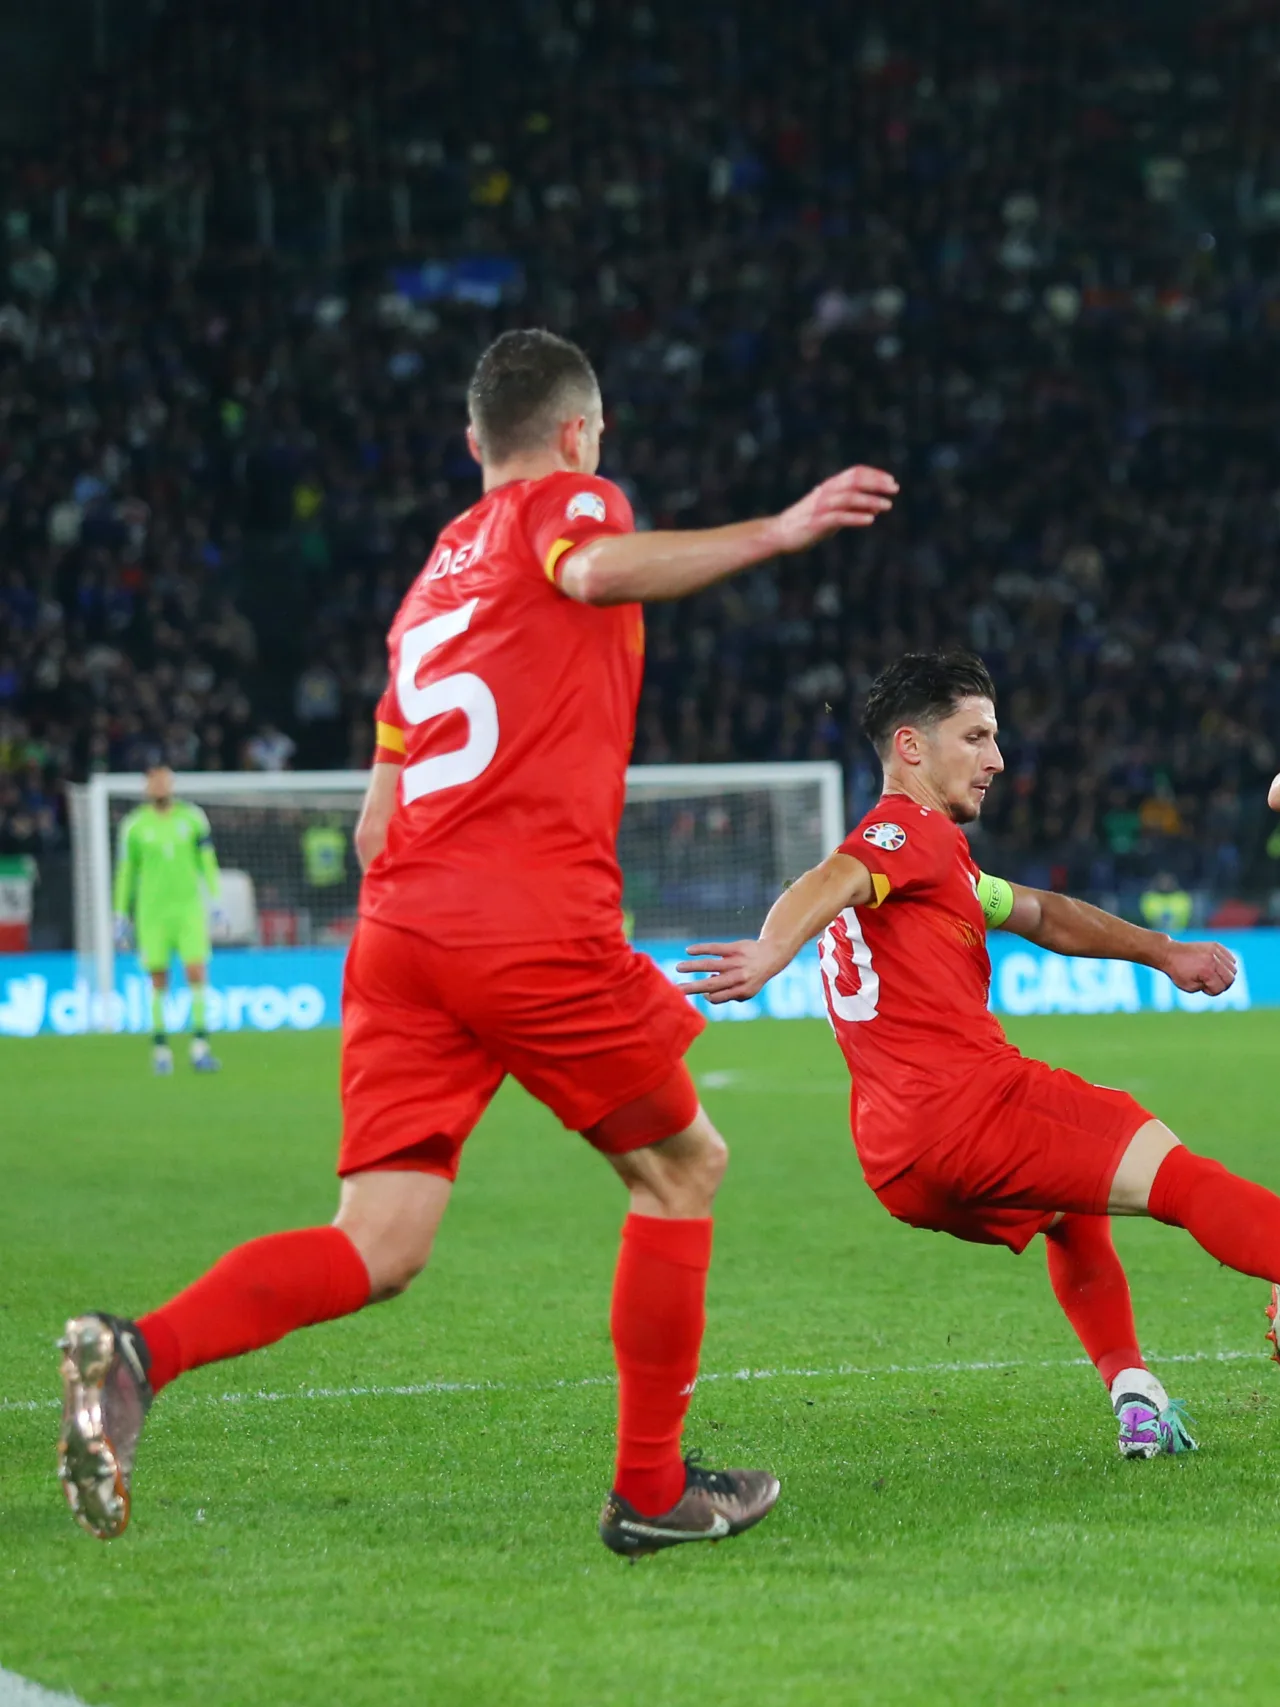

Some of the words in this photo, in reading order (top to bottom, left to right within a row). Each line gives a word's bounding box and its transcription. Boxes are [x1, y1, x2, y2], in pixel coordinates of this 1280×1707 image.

[396, 597, 499, 806] 5
[817, 906, 880, 1038] 0
[1000, 950, 1142, 1016] CASA
